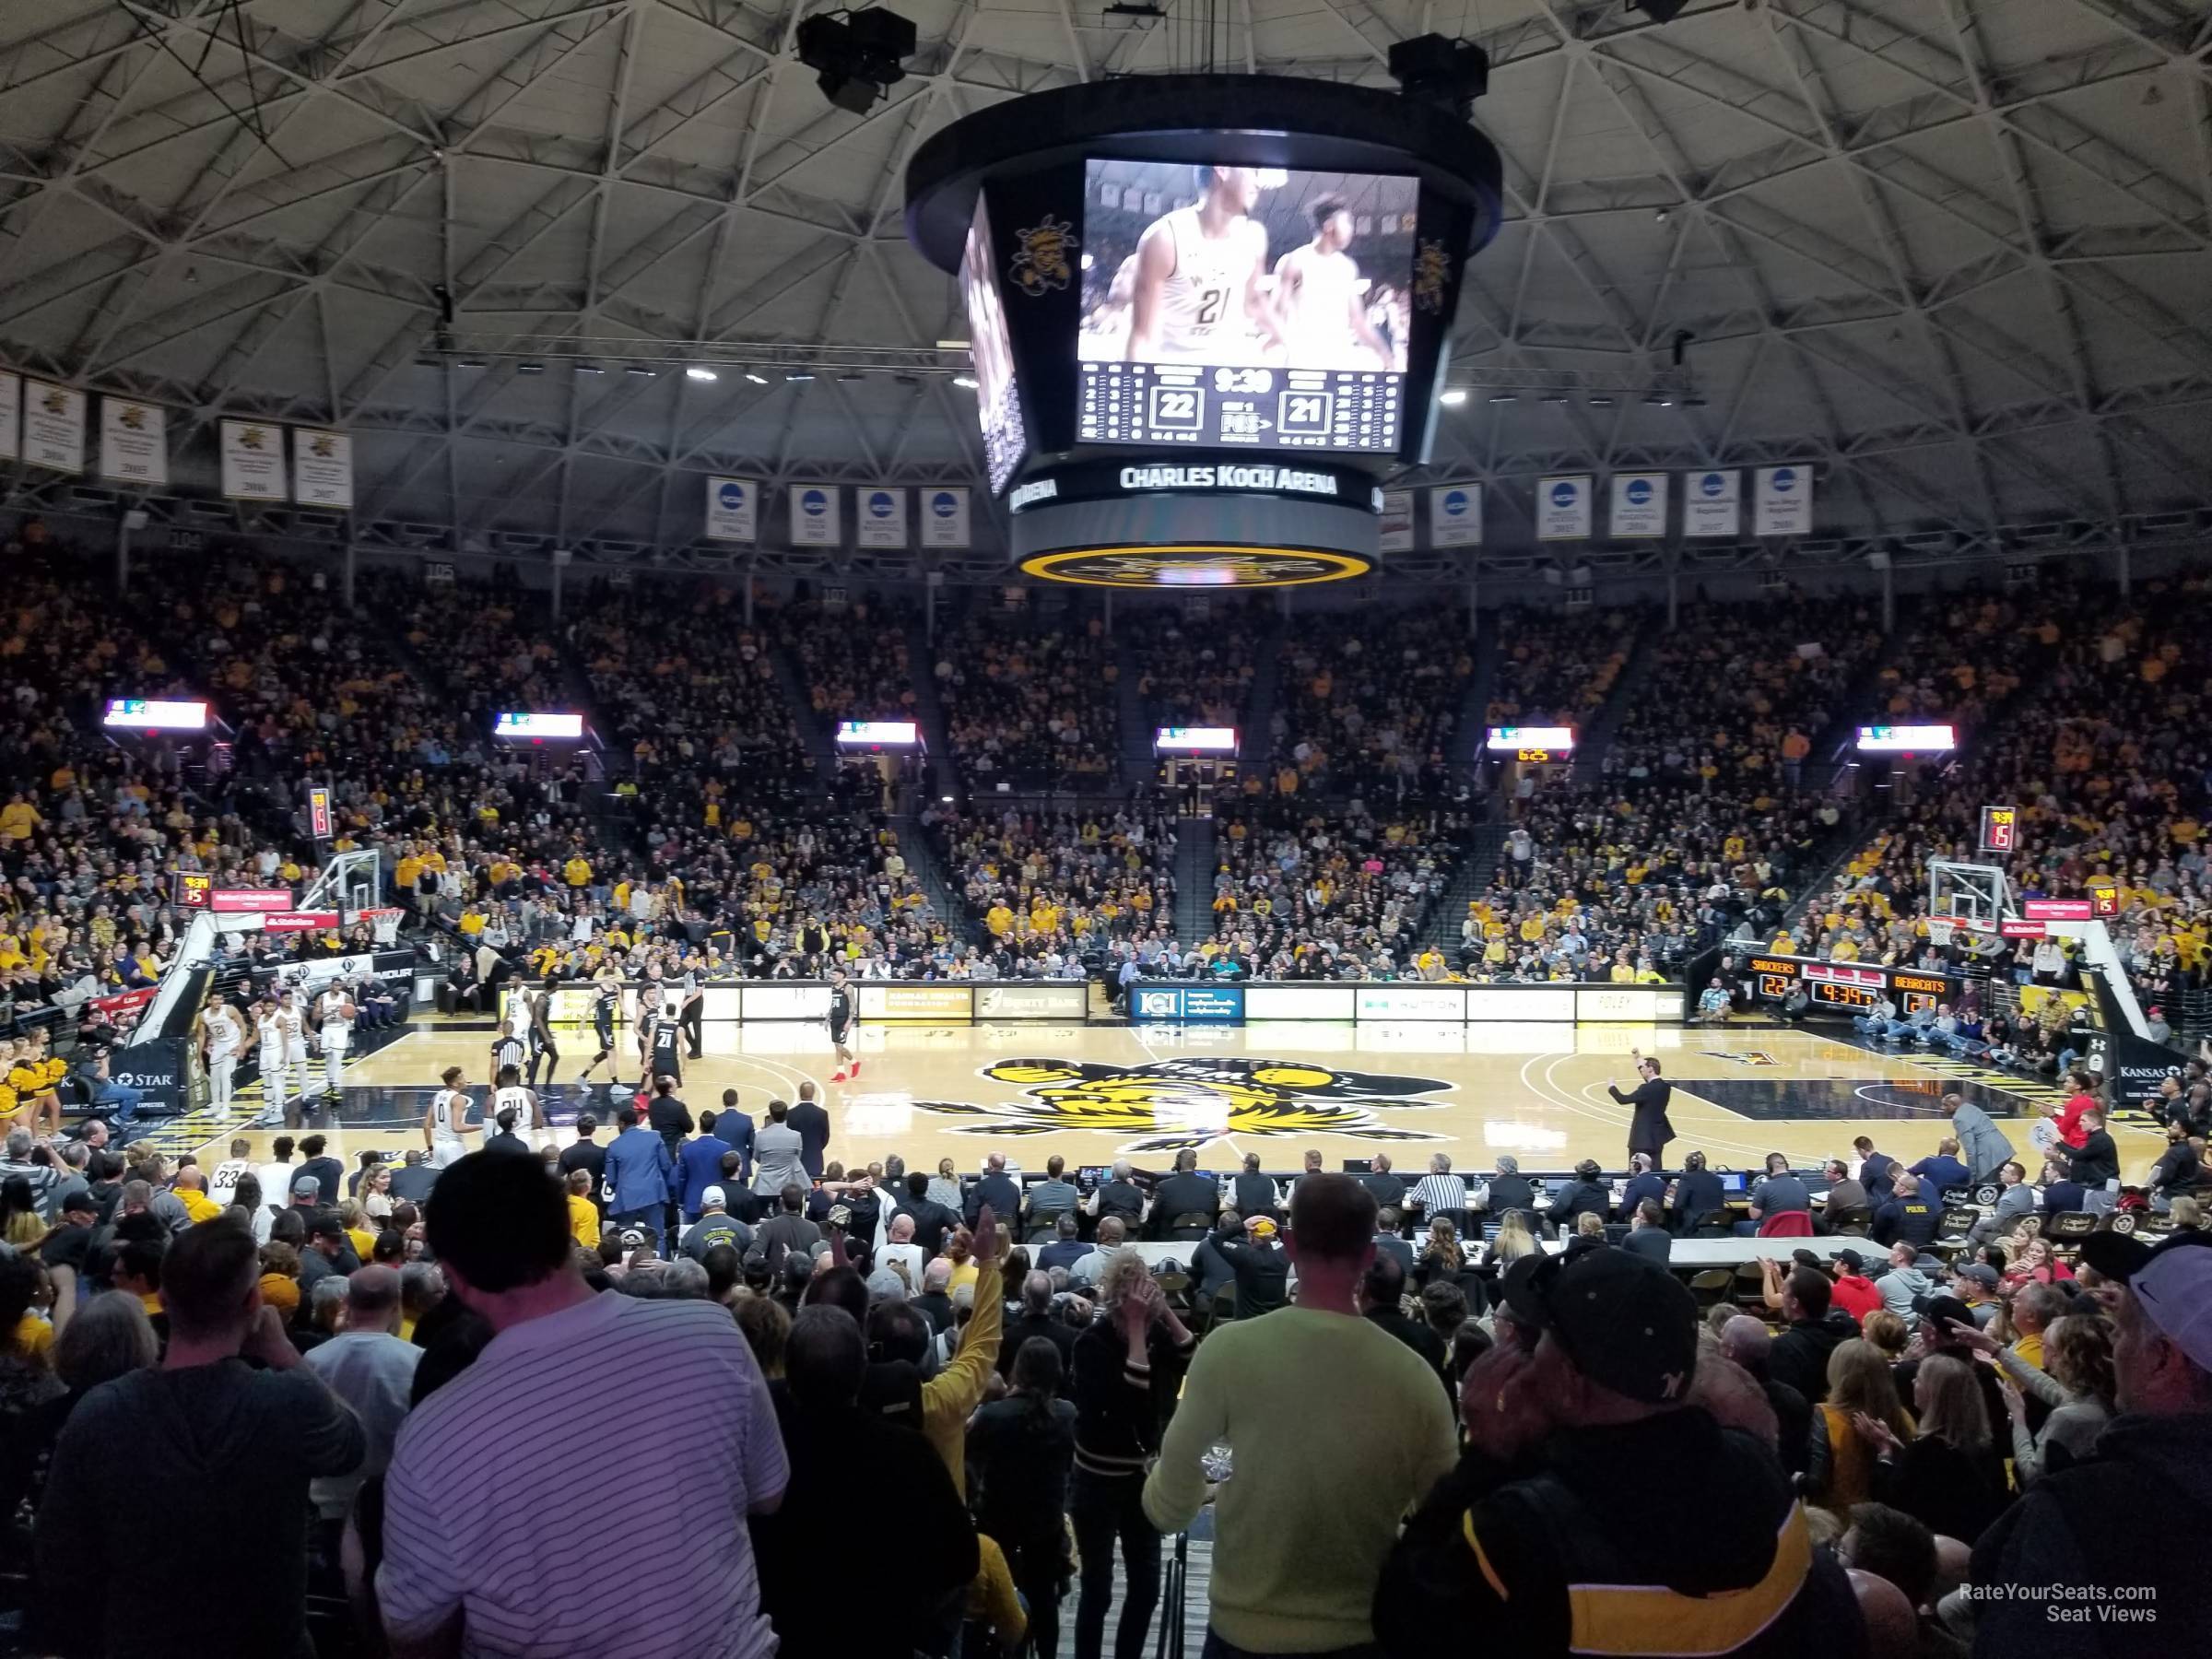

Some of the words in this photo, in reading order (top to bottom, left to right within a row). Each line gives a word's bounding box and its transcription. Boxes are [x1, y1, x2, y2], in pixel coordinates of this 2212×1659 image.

[1087, 376, 1096, 385] 1
[1134, 378, 1144, 388] 1
[1159, 393, 1195, 418] 22
[1288, 397, 1321, 422] 21
[1120, 467, 1216, 488] CHARLES
[1217, 465, 1276, 488] KOCH
[1276, 468, 1338, 495] ARENA
[426, 563, 453, 582] 105
[187, 889, 202, 903] 15
[1752, 959, 1795, 975] SHOCKERS
[1765, 977, 1785, 995] 22
[1895, 976, 1947, 993] BEARCATS
[1823, 984, 1861, 1004] 9:39
[214, 1024, 227, 1036] 21
[657, 1033, 672, 1048] 21
[135, 1074, 173, 1086] STAR
[2121, 1067, 2166, 1077] KANSAS
[438, 1103, 444, 1123] 0
[214, 1170, 240, 1188] 33
